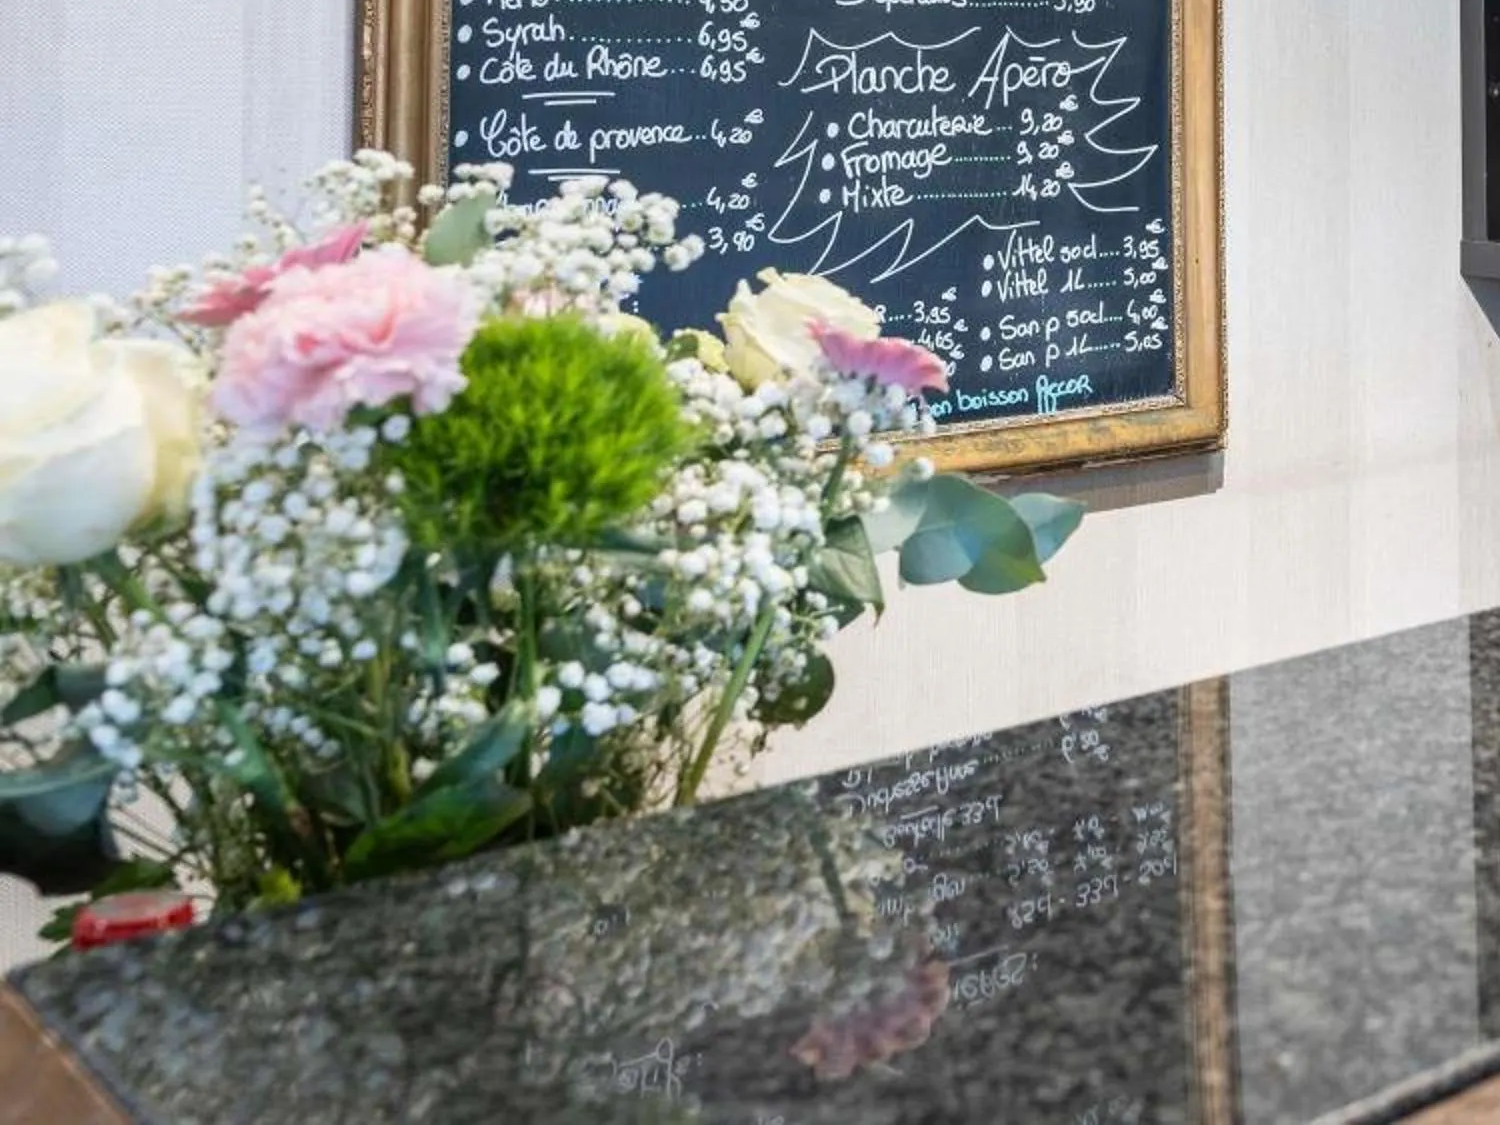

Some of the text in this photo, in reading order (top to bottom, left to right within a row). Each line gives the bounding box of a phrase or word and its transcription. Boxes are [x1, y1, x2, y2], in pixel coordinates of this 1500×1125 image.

[483, 13, 565, 61] Syrah
[480, 49, 537, 84] Côte
[544, 52, 579, 81] du
[587, 44, 668, 81] Rhône
[801, 49, 957, 95] Planche
[554, 120, 582, 151] de
[590, 124, 693, 164] provence
[841, 141, 952, 179] Fromage
[842, 175, 914, 213] Mixte
[997, 228, 1055, 271] Vittel
[996, 271, 1049, 303] Vittel
[999, 316, 1039, 340] San
[999, 348, 1036, 370] San
[956, 388, 1029, 414] boisson
